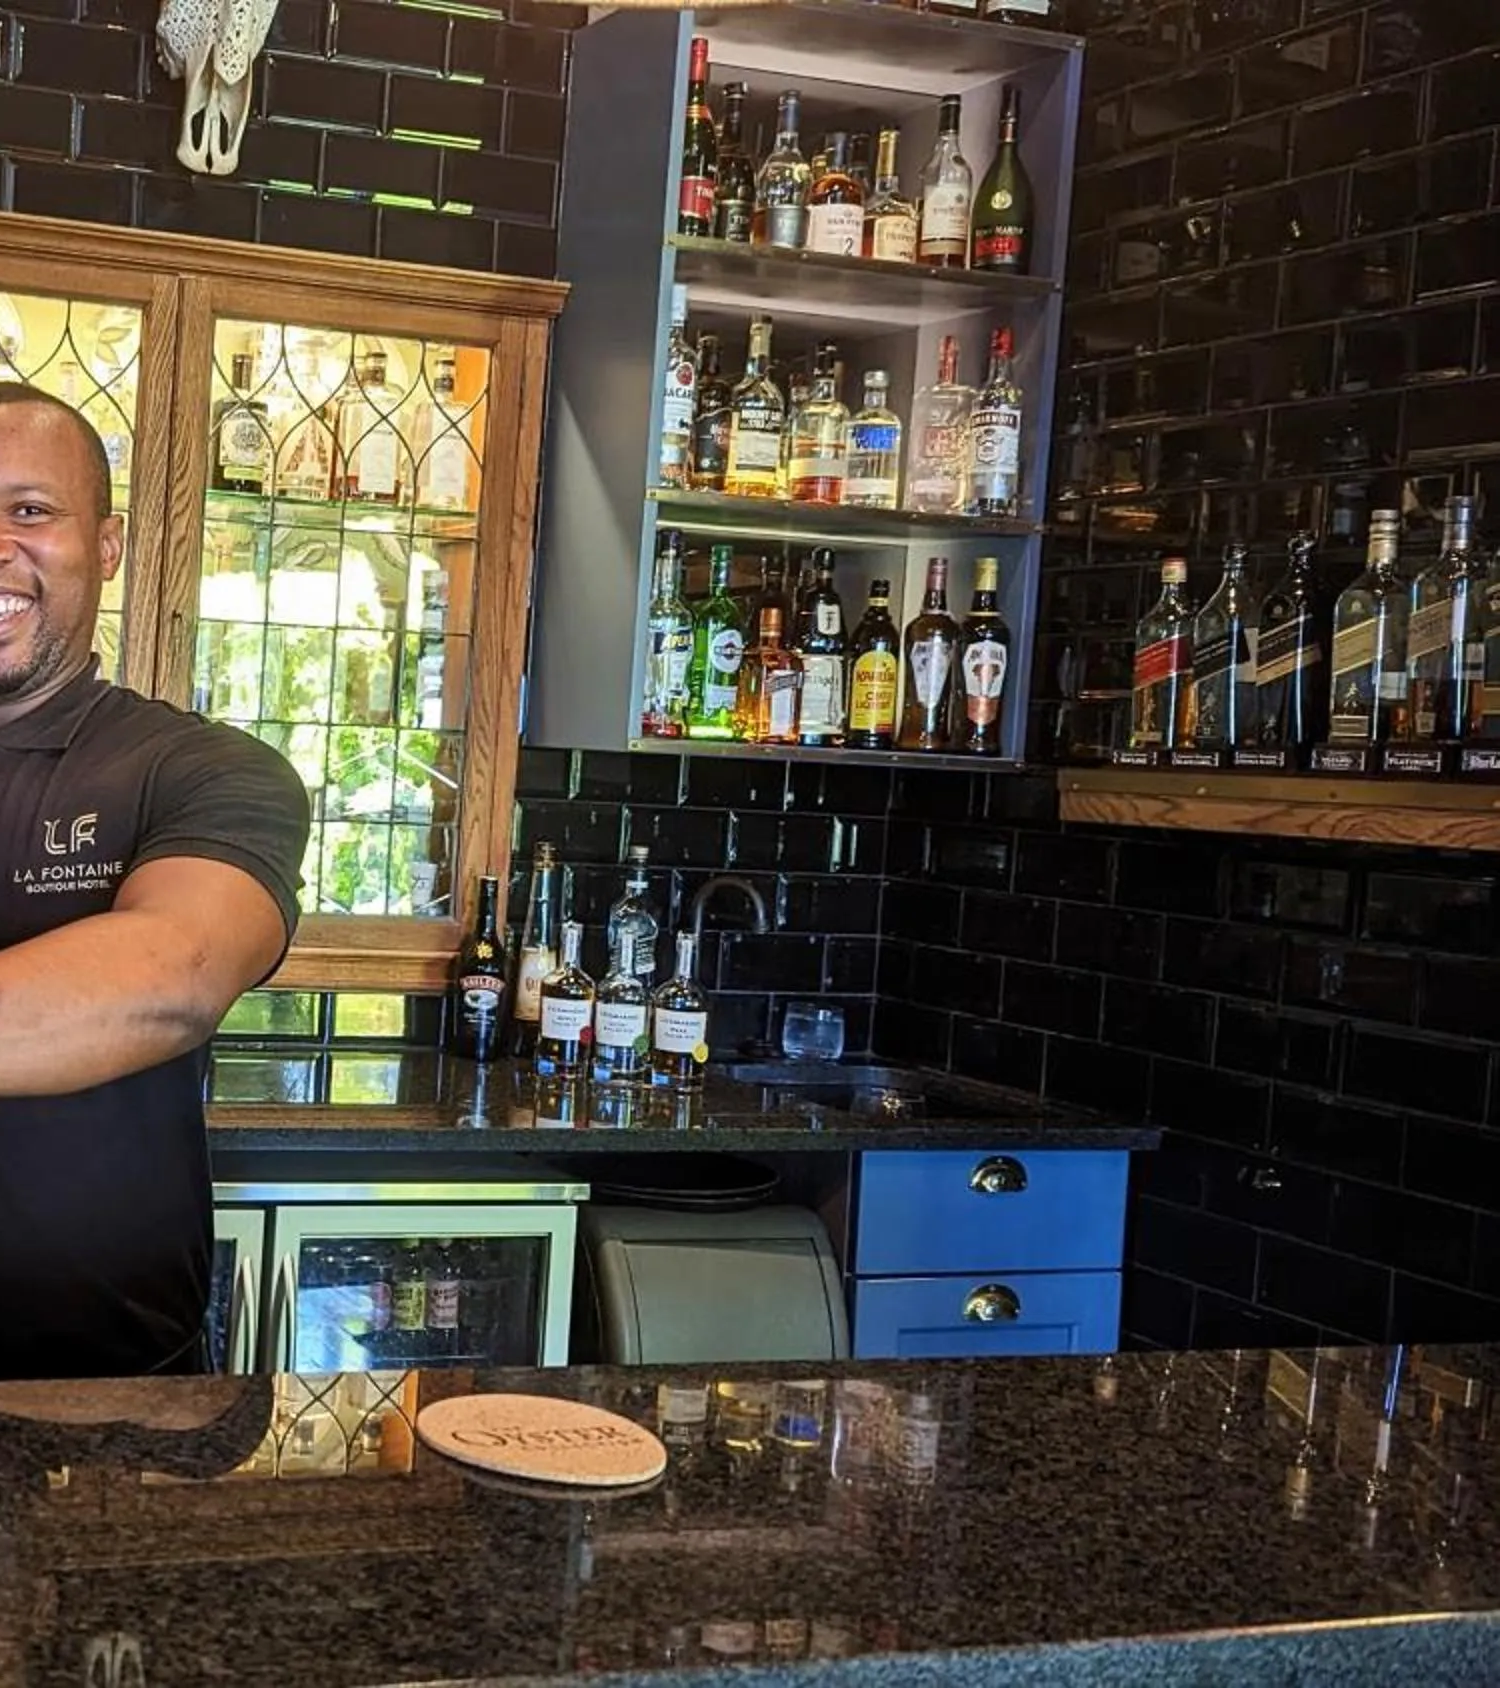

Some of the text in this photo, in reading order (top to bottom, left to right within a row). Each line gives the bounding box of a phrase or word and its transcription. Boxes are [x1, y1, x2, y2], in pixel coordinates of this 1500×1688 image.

[13, 860, 125, 883] LA FONTAINE
[25, 878, 111, 895] BOUTIQUE HOTEL
